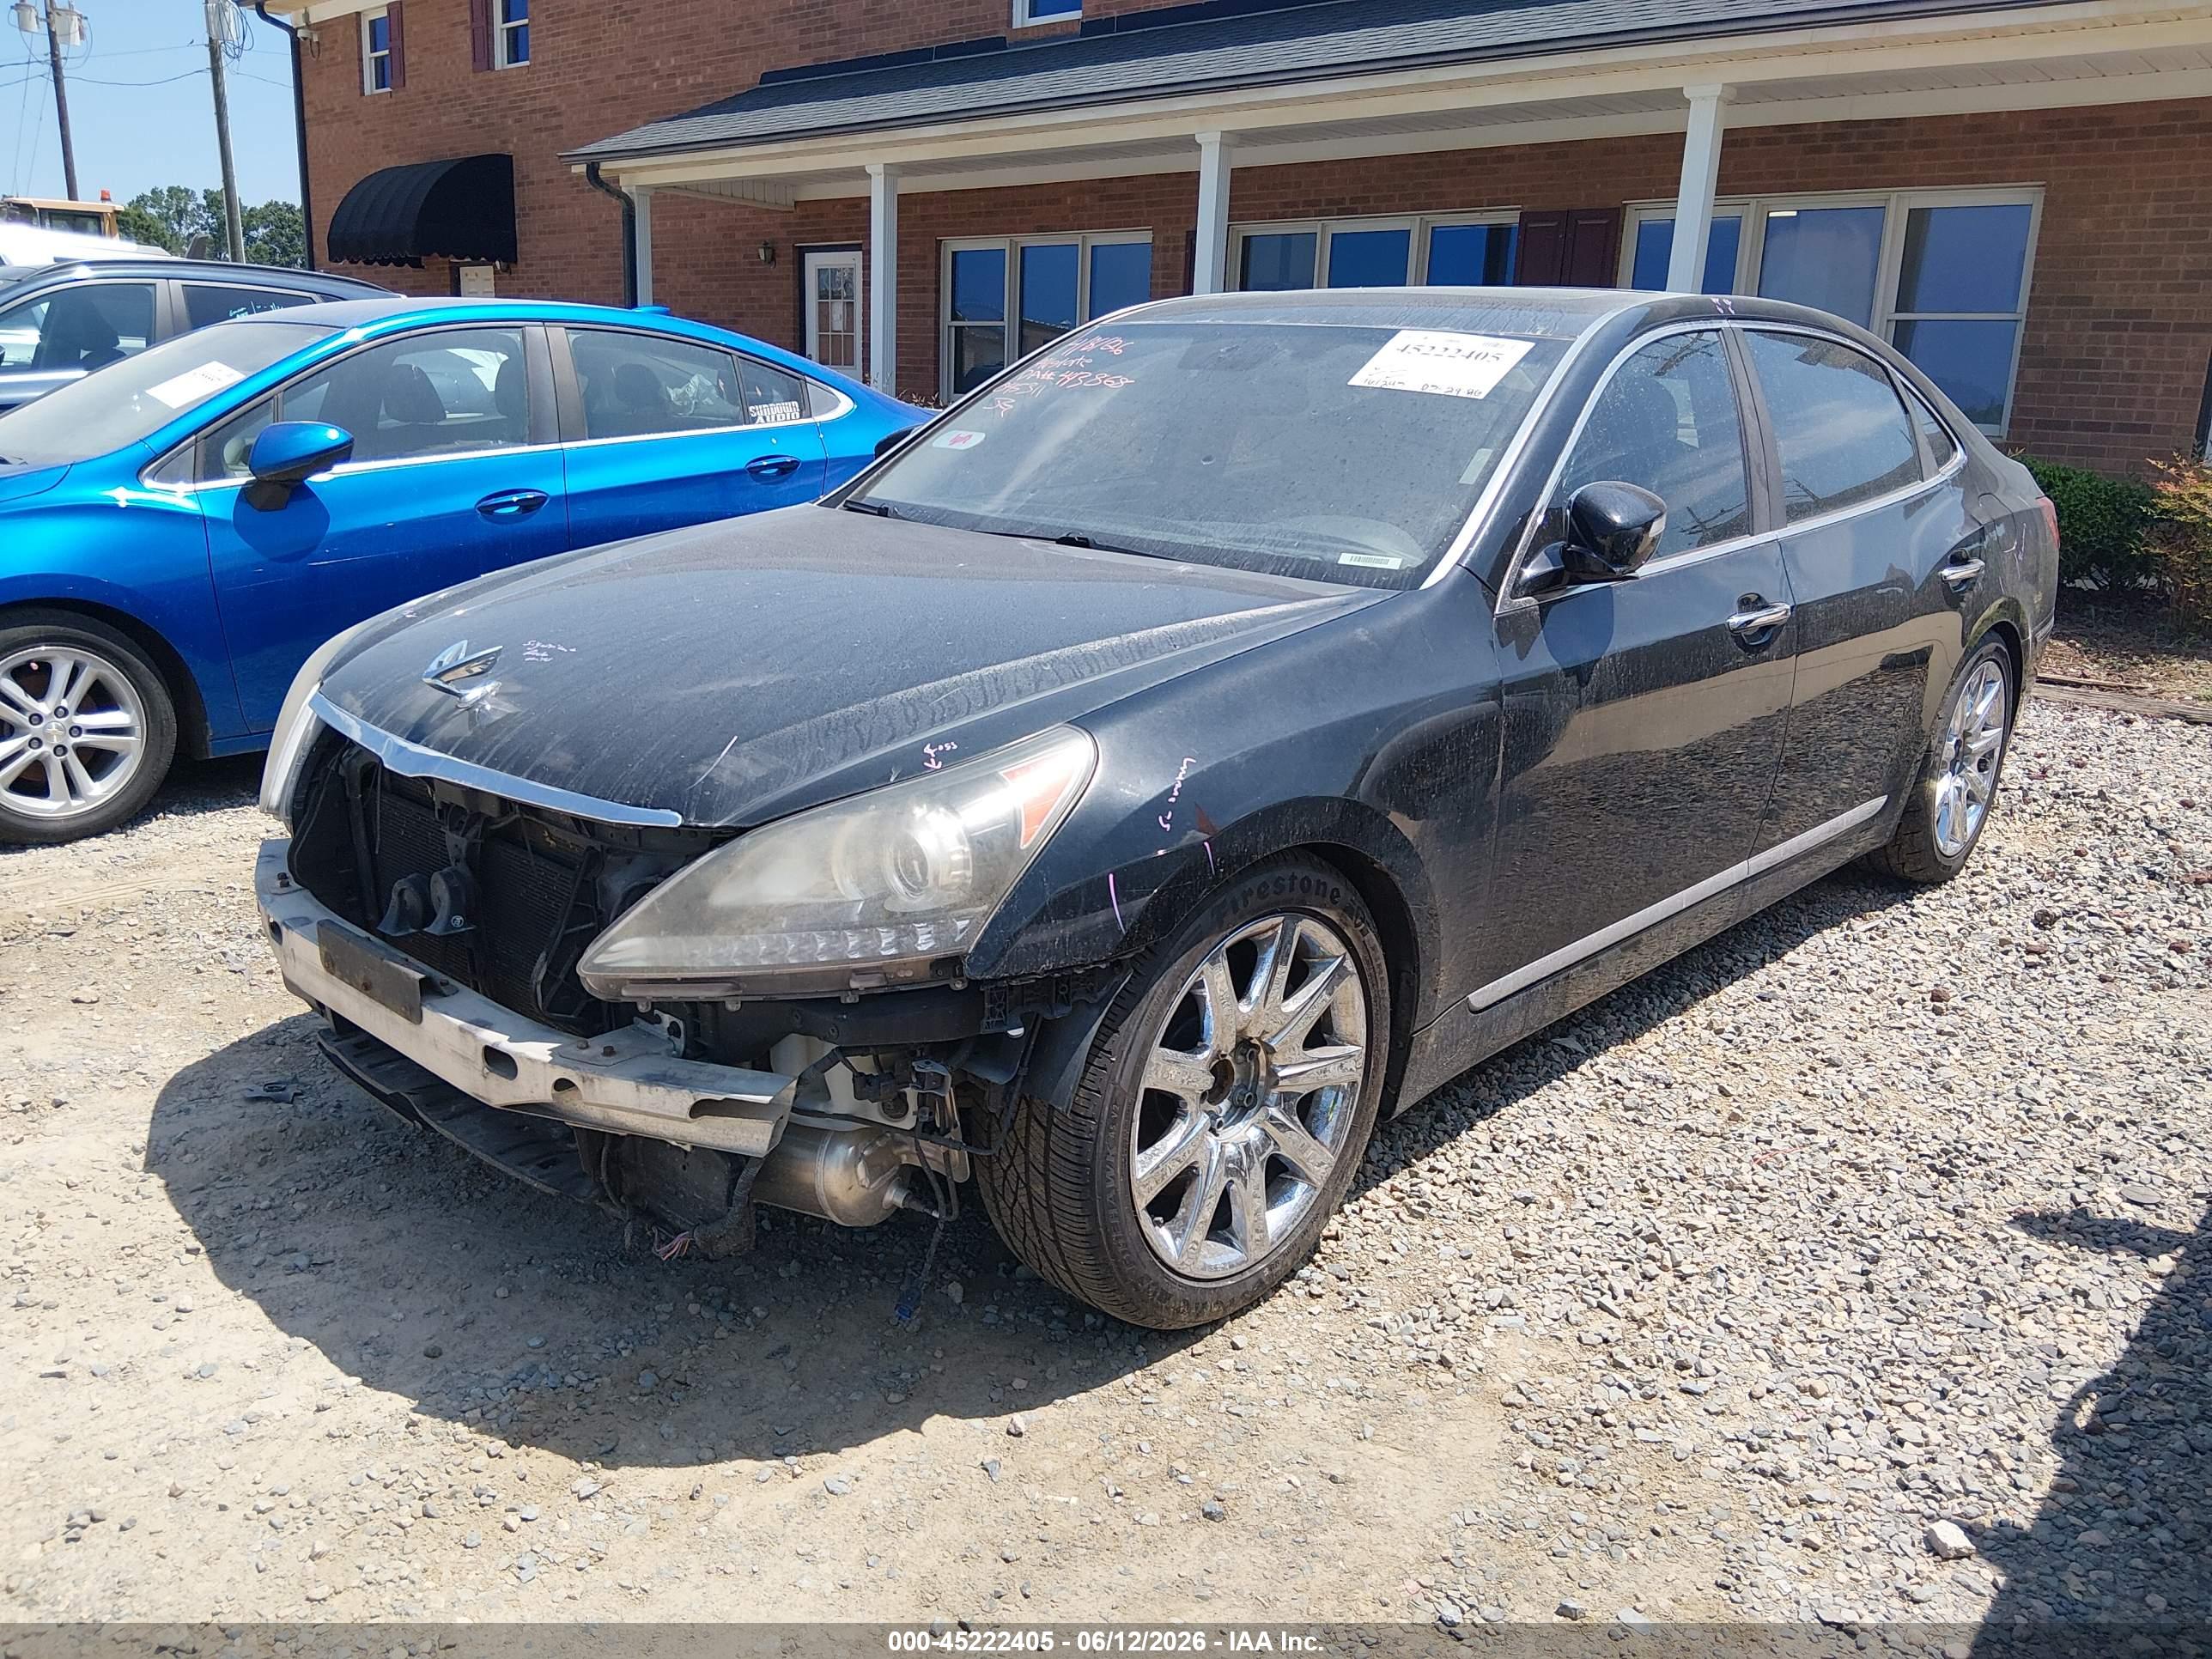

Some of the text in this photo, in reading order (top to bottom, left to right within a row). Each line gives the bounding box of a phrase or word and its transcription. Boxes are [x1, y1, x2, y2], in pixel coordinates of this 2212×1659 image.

[1396, 343, 1504, 363] 45222405
[749, 400, 800, 417] SUNDOWN
[756, 412, 800, 424] AUDIO
